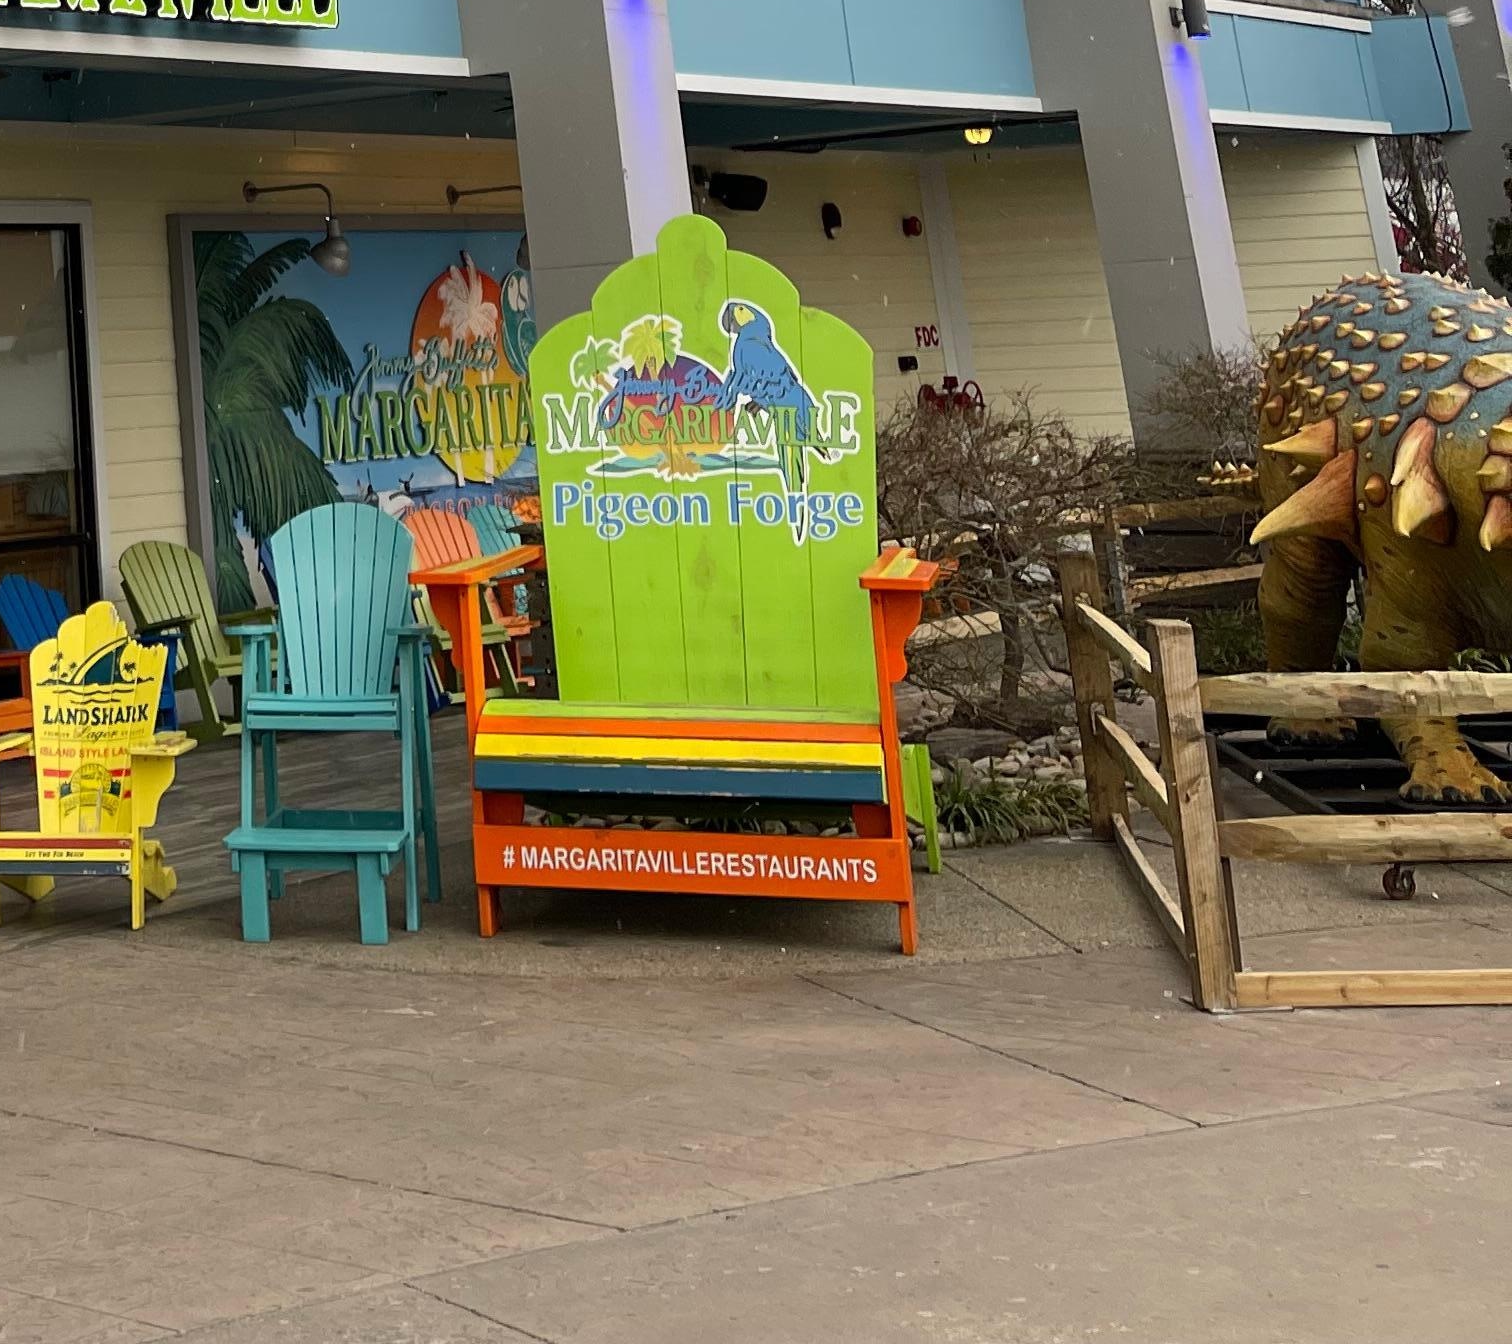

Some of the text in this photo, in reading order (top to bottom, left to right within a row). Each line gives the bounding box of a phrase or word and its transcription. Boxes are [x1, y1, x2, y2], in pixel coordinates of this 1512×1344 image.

[914, 322, 940, 349] FDC
[599, 367, 677, 430] Jimmy
[544, 392, 858, 450] MARGARITAVILLE
[552, 479, 864, 540] Pigeon Forge
[43, 703, 149, 726] LANDSHARK
[79, 745, 108, 760] STYLE
[521, 846, 877, 883] MARGARITAVILLERESTAURANTS
